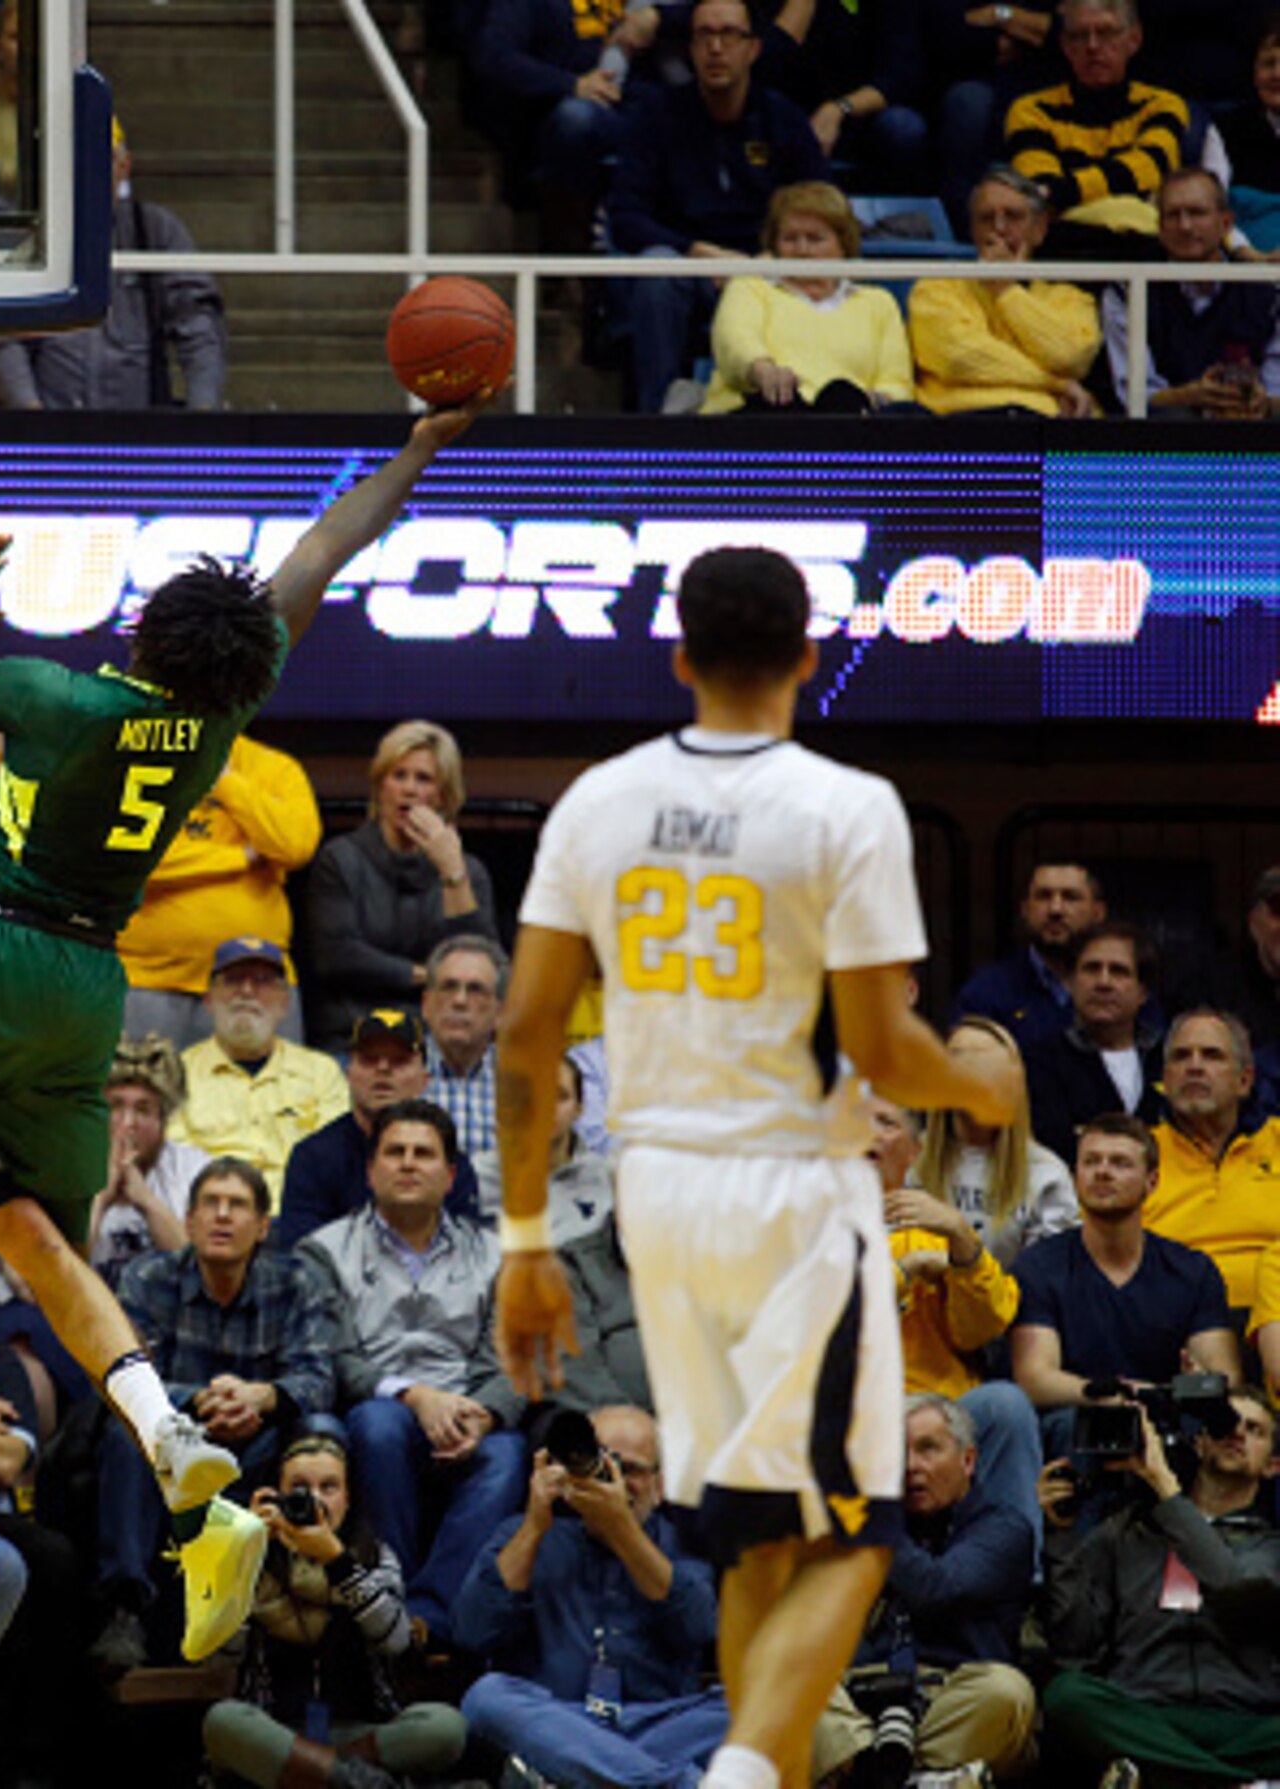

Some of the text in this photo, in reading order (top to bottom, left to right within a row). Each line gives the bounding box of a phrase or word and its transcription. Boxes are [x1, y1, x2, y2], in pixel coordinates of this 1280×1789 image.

[116, 717, 204, 752] MOTLEY
[105, 764, 175, 851] 5
[616, 865, 766, 1001] 23
